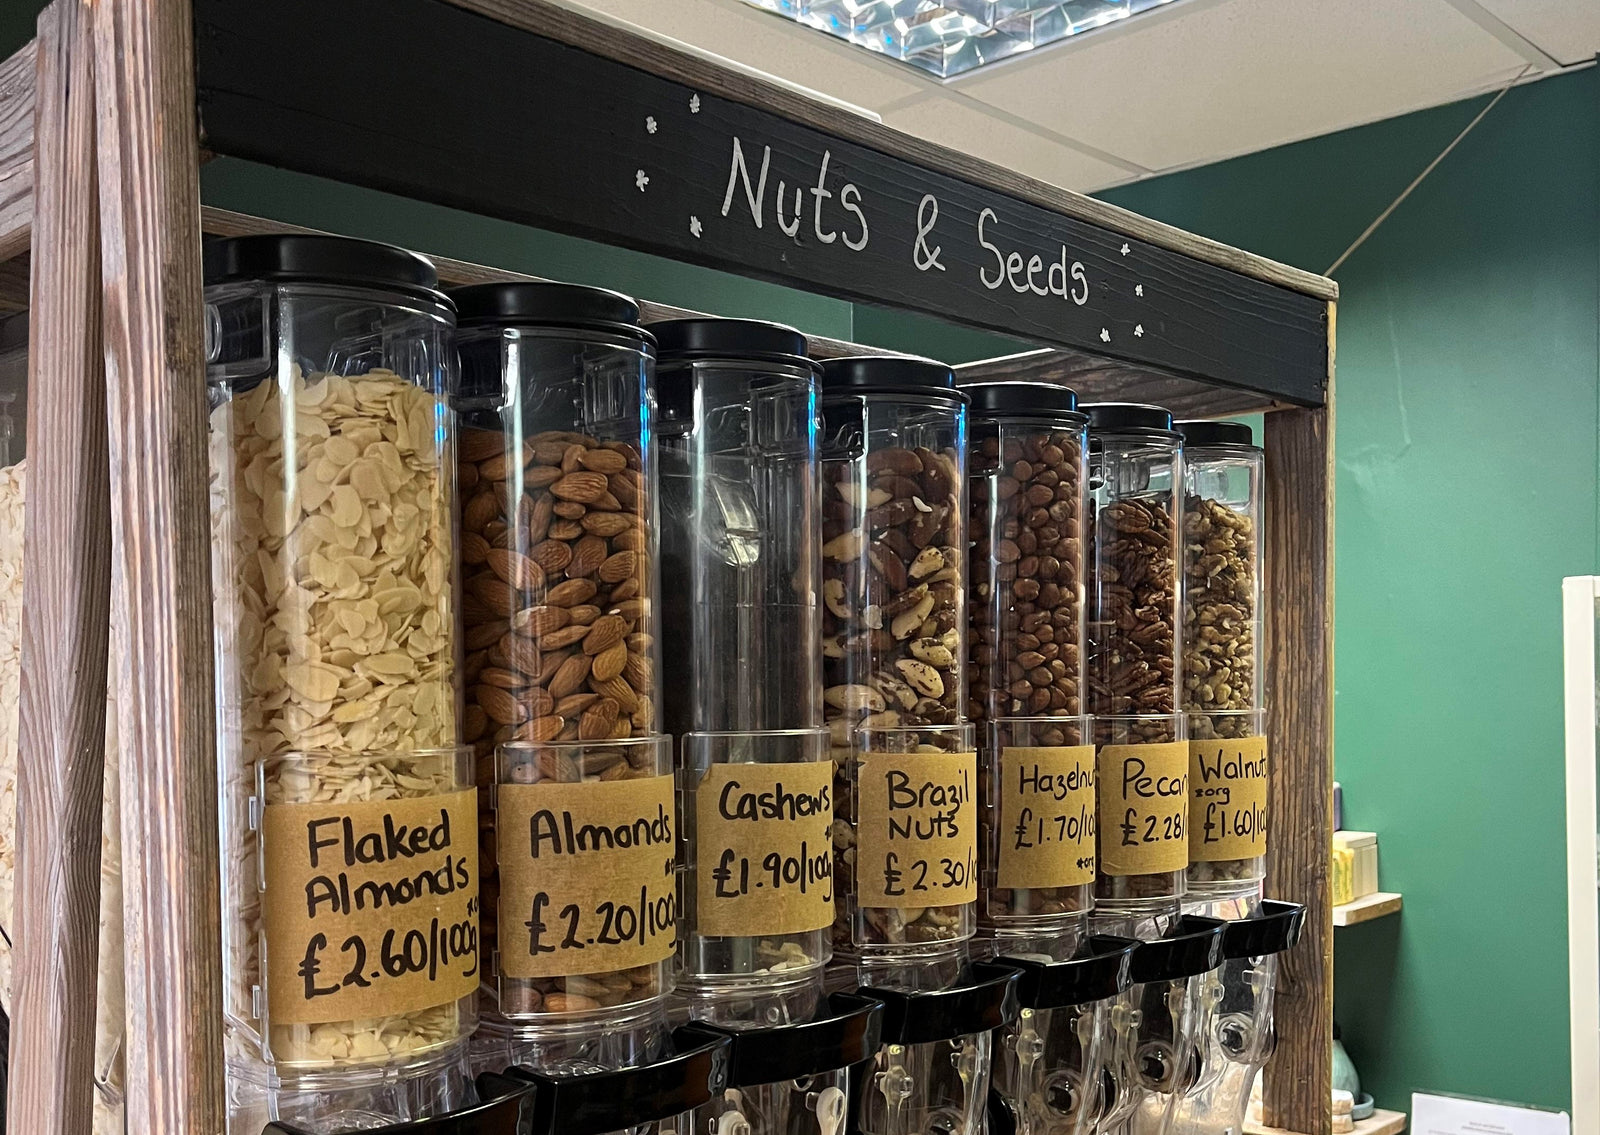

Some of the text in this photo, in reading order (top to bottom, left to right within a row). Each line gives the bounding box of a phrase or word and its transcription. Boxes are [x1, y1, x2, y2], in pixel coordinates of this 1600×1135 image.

[721, 136, 1090, 306] Nuts & Seeds
[718, 780, 831, 822] Cashews
[884, 769, 969, 816] Brazil
[306, 808, 451, 868] Flaked
[529, 803, 672, 858] Almonds
[304, 854, 469, 919] Almonds
[524, 885, 677, 956] £2.20/100
[297, 917, 478, 1000] £2.60/100g
